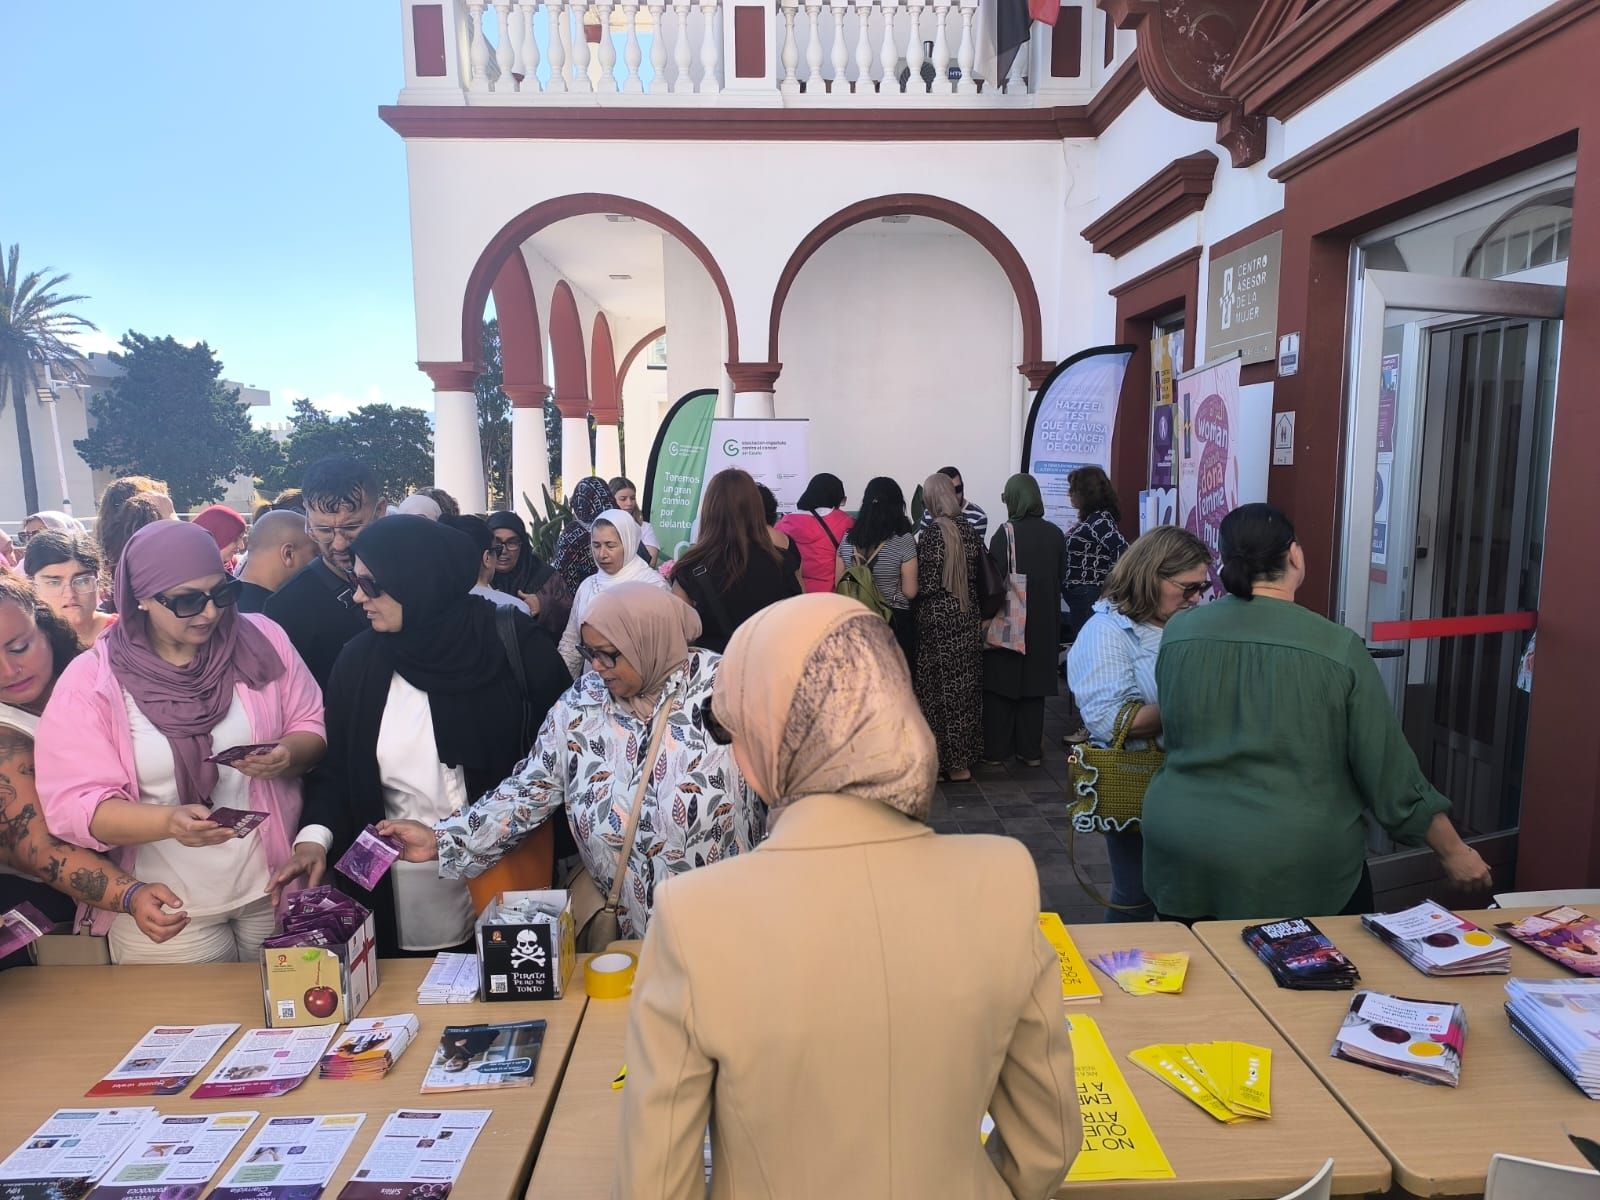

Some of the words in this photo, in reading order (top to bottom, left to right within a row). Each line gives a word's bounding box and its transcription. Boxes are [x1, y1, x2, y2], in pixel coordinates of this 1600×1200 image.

[1237, 254, 1268, 277] CENTRO
[1237, 271, 1267, 291] ASESOR
[1236, 294, 1247, 309] DE
[1247, 291, 1257, 306] LA
[1235, 306, 1260, 323] MUJER
[1056, 400, 1090, 411] HAZTE
[1091, 402, 1104, 412] EL
[1065, 412, 1091, 421] TEST
[1041, 421, 1063, 430] QUE
[1065, 422, 1079, 431] TE
[1079, 423, 1108, 433] AVISA
[1041, 432, 1062, 441] DEL
[1198, 418, 1229, 450] woman
[1046, 442, 1062, 451] DE
[1062, 442, 1097, 453] COLON
[1201, 462, 1224, 494] dona
[664, 485, 674, 493] un
[674, 487, 692, 496] gran
[661, 496, 690, 506] camino
[1198, 486, 1226, 521] femme
[660, 509, 674, 519] por
[659, 519, 692, 530] delante
[511, 972, 546, 980] PIRATA
[1091, 1082, 1104, 1092] A
[1081, 1111, 1119, 1123] ATR
[1082, 1123, 1127, 1137] QUE
[1080, 1139, 1099, 1152] T
[1102, 1138, 1136, 1151] NO
